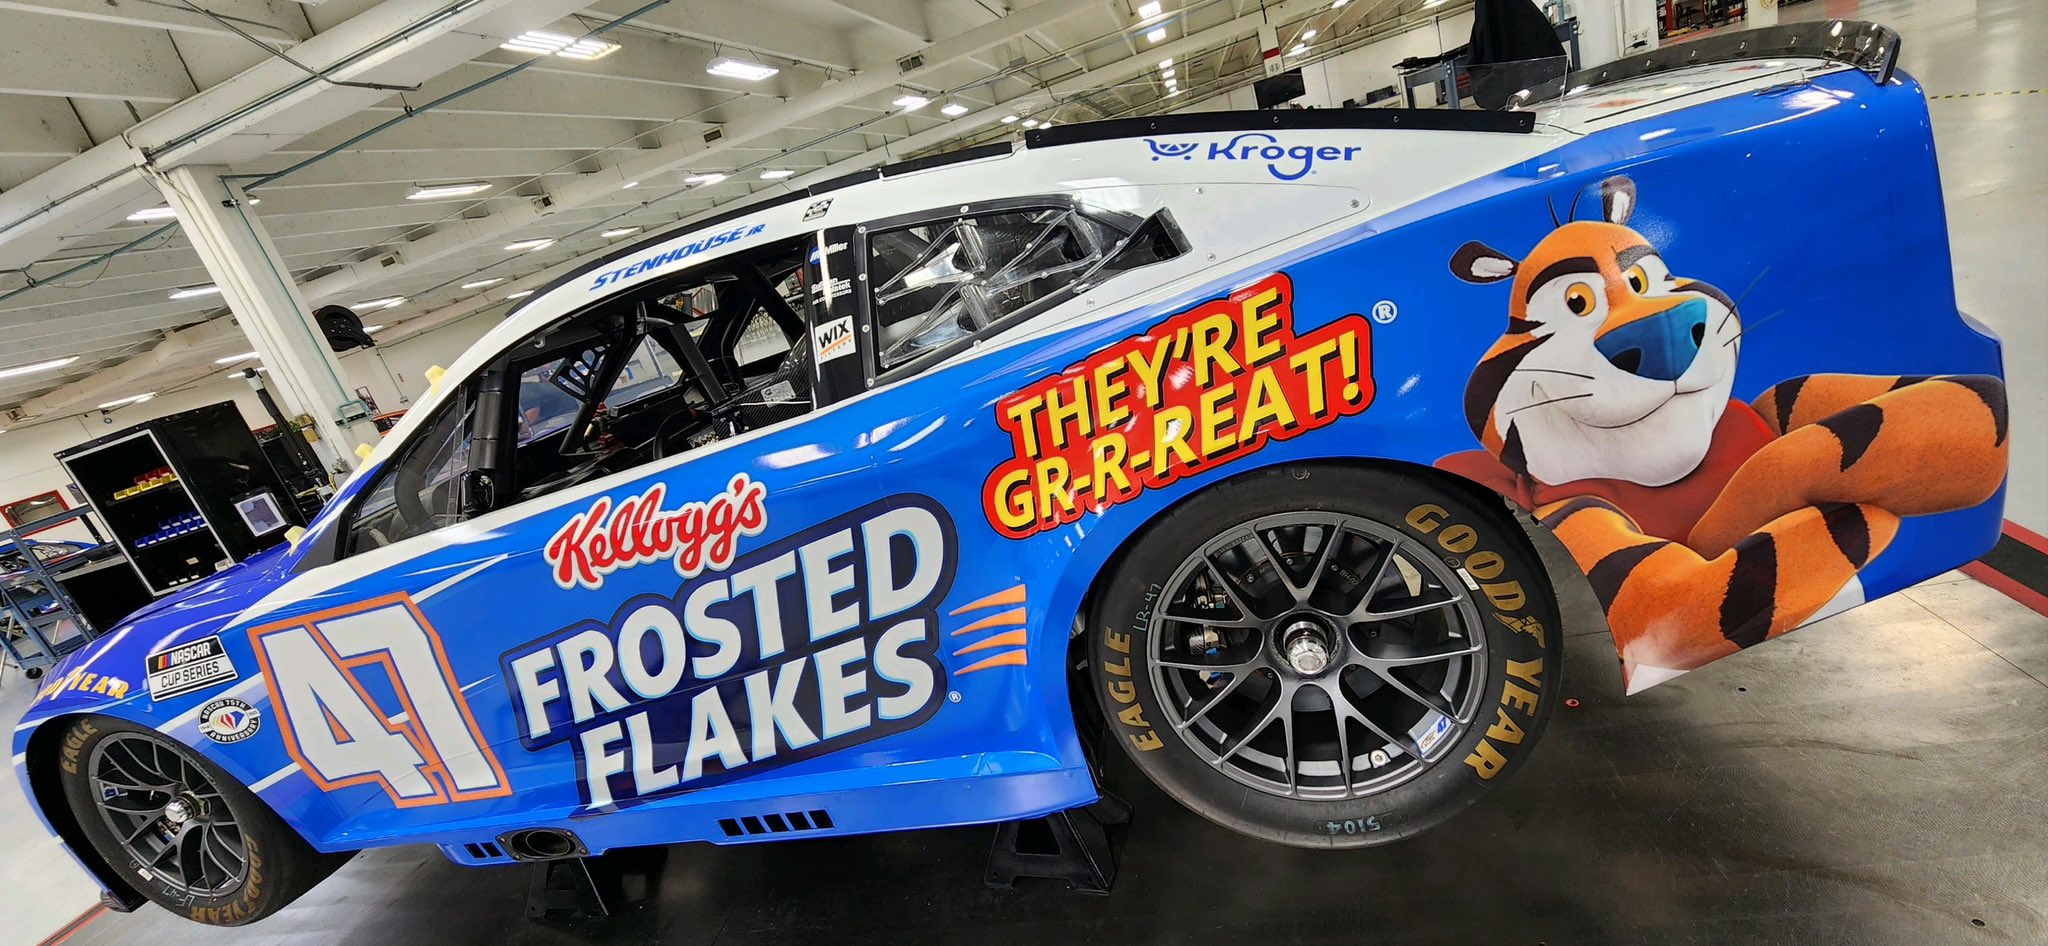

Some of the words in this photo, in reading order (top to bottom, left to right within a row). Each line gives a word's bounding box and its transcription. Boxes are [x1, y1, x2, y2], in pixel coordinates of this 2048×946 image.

[1207, 133, 1362, 181] Kroger
[588, 225, 748, 292] STENHOUSE
[745, 223, 767, 239] JR
[818, 319, 850, 348] WIX
[1005, 286, 1284, 459] THEY'RE
[994, 329, 1361, 528] GR-R-REAT!
[549, 477, 763, 584] Kellogg's
[1405, 503, 1527, 613] GOOD
[171, 642, 211, 666] NASCAR
[511, 506, 945, 739] FROSTED
[1132, 583, 1161, 631] LR-47
[161, 671, 181, 688] CUP
[183, 661, 220, 682] SERIES
[255, 597, 503, 801] 47
[579, 618, 935, 811] FLAKES
[1105, 627, 1165, 752] EAGLE
[1462, 657, 1544, 782] YEAR
[61, 717, 99, 775] EAGLE
[210, 719, 258, 742] ANNIVERSARY
